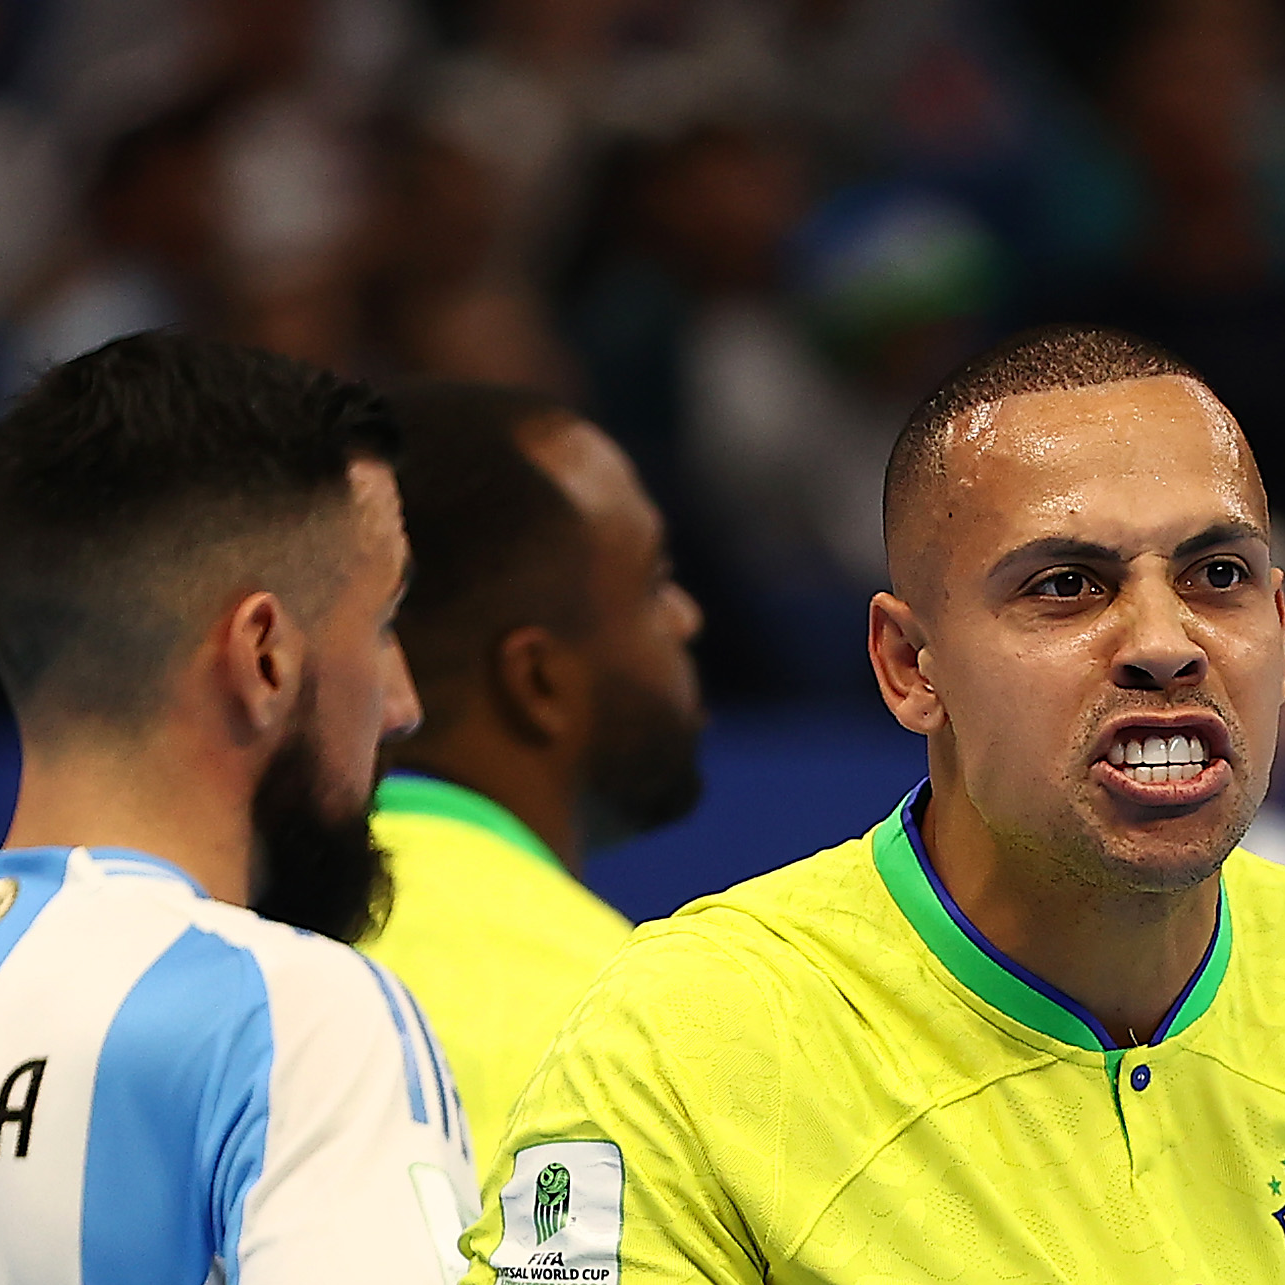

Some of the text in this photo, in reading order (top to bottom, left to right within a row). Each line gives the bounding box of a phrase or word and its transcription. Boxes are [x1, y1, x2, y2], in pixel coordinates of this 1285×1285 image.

[527, 1252, 565, 1267] FIFA
[530, 1267, 580, 1281] WORLD
[582, 1269, 610, 1281] CUP
